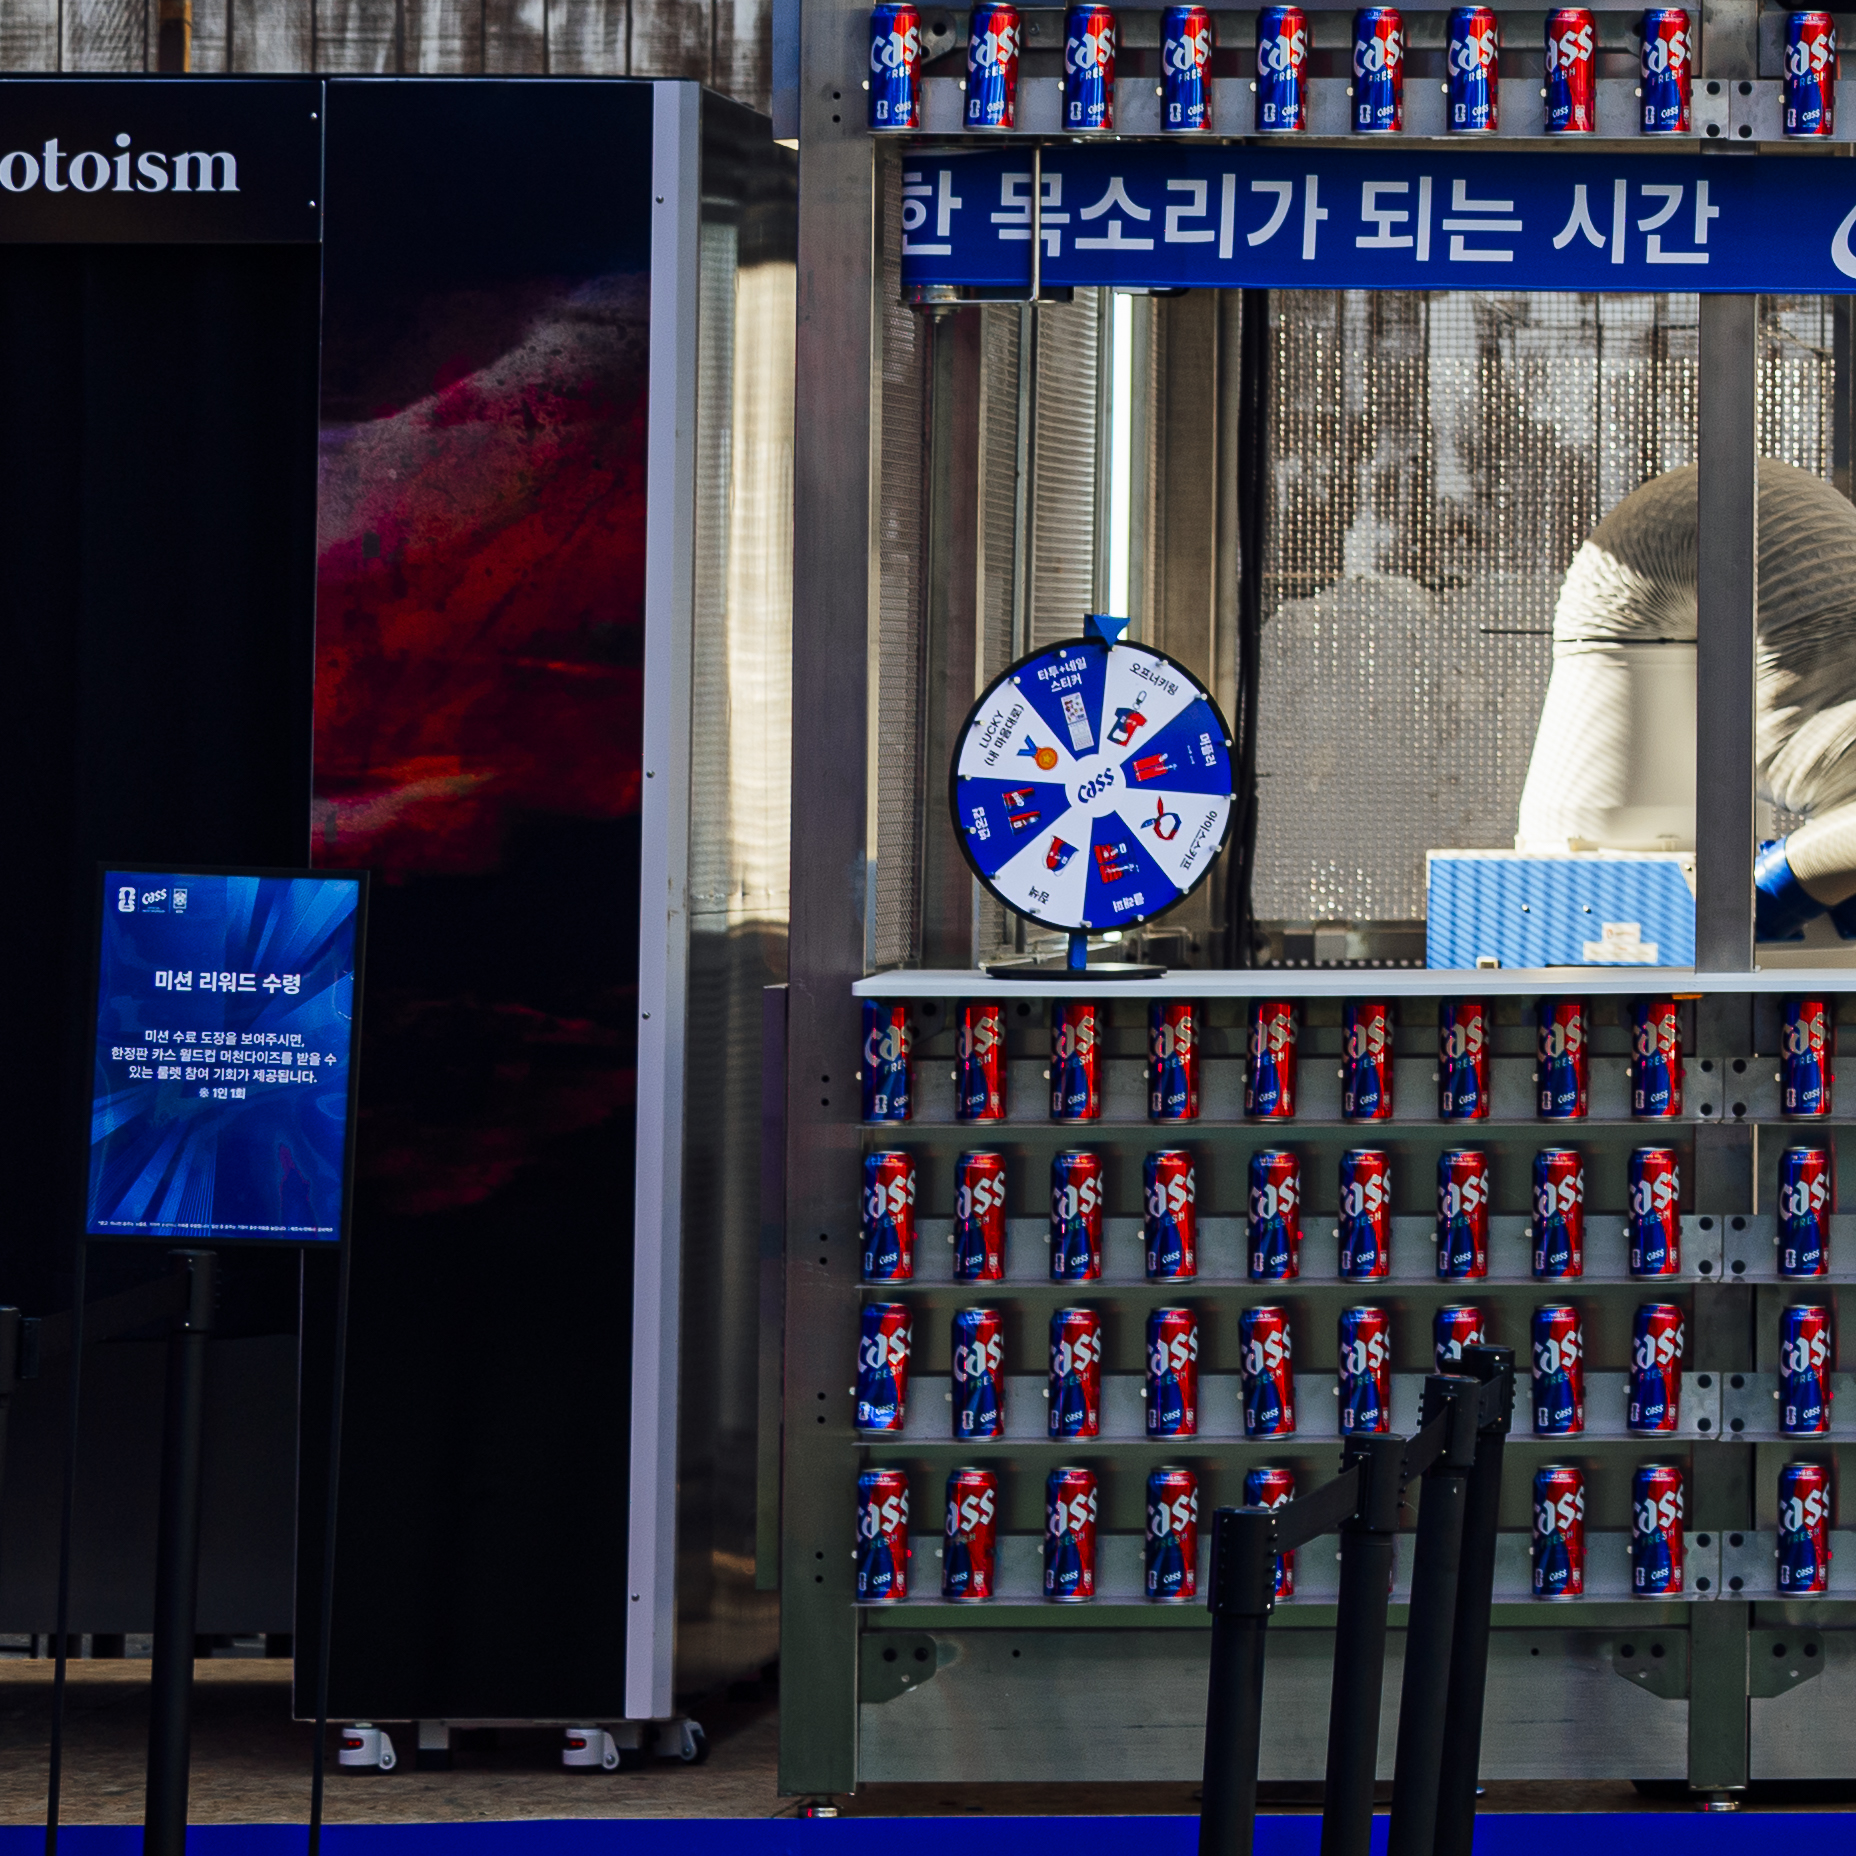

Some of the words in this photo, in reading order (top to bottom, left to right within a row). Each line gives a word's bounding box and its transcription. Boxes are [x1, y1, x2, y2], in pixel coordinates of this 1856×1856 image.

[991, 171, 1327, 263] 목소리가
[1355, 175, 1523, 263] 되는
[1553, 178, 1720, 266] 시간
[1051, 674, 1082, 692] 스티커
[1129, 662, 1179, 696] 오프너키링
[978, 709, 1004, 750] LUCKY
[155, 970, 192, 991] 미션
[200, 972, 257, 993] 리워드
[262, 973, 301, 995] 수령
[145, 1030, 169, 1043] 미션
[172, 1030, 195, 1044] 수료
[201, 1031, 237, 1045] 도장을
[111, 1047, 148, 1061] 한정판
[152, 1048, 176, 1062] 카스
[297, 1052, 321, 1066] 받을
[325, 1054, 337, 1066] 수
[129, 1066, 153, 1079] 있는
[186, 1066, 209, 1081] 참여
[213, 1068, 250, 1082] 기회가
